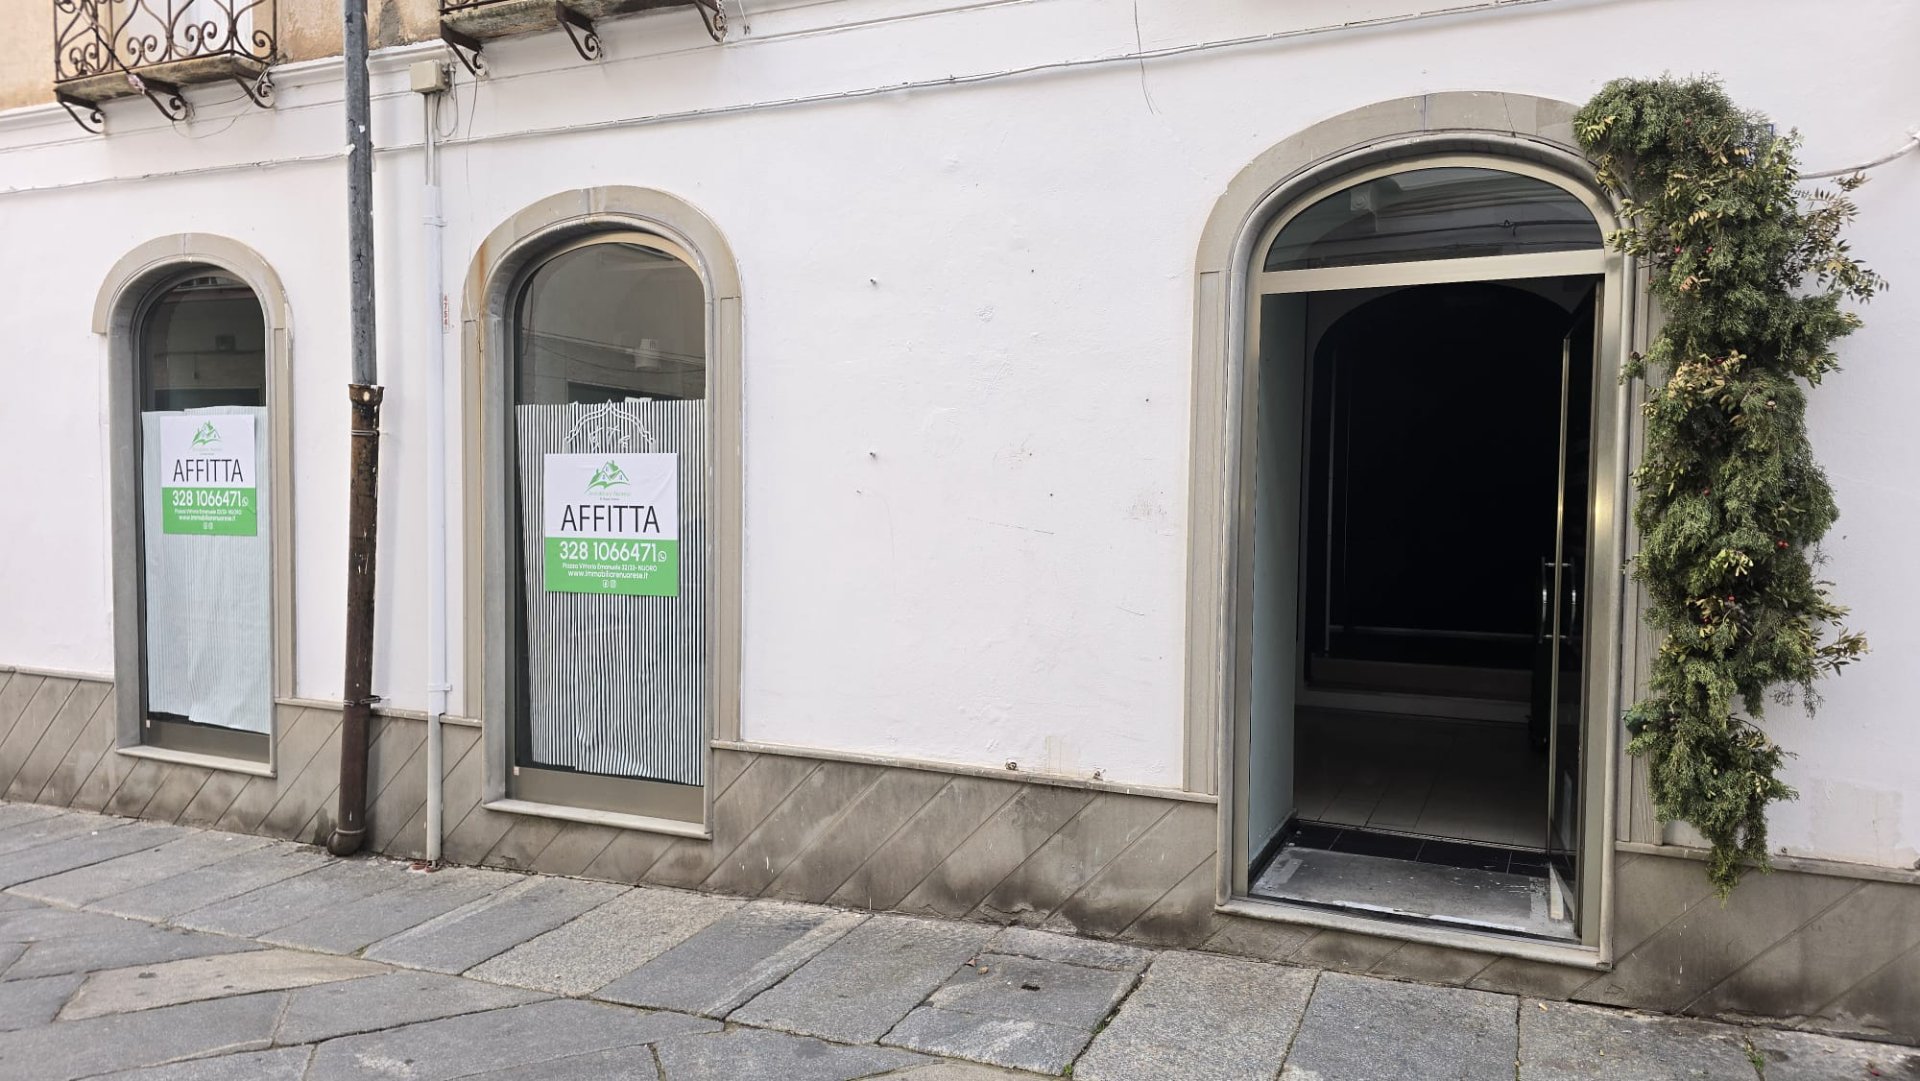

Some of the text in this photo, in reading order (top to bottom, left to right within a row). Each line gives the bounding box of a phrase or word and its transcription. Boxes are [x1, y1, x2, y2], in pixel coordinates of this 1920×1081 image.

[173, 459, 244, 482] AFFITTA
[172, 489, 242, 507] 328 1066471
[561, 504, 661, 533] AFFITTA
[560, 541, 657, 562] 328 1066471
